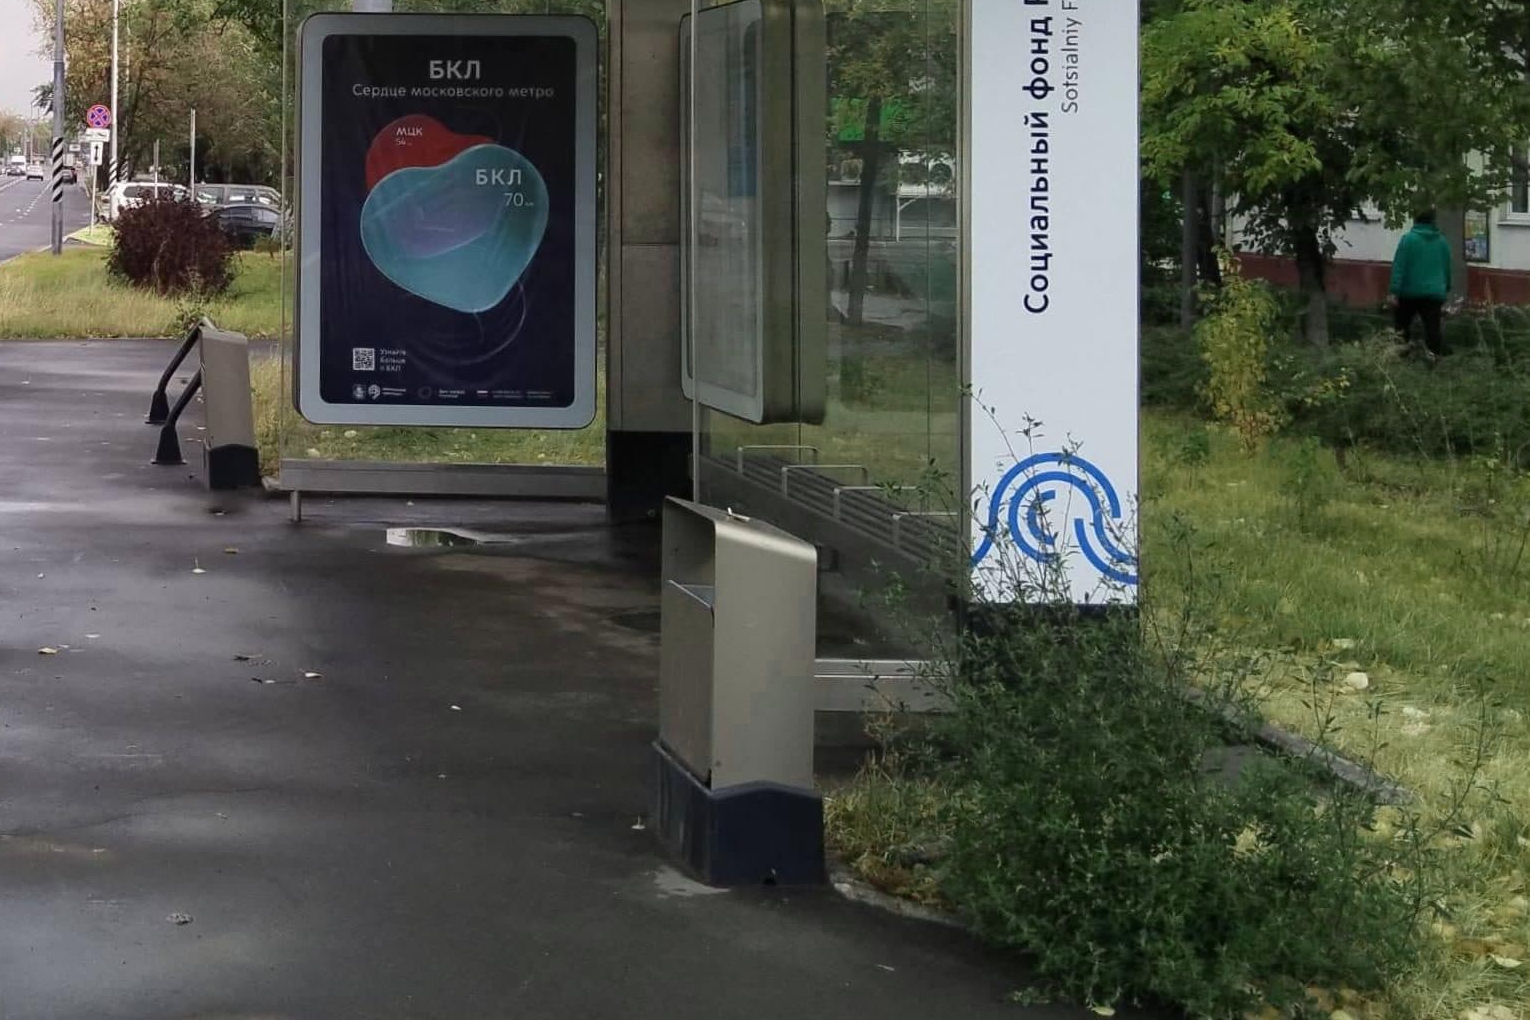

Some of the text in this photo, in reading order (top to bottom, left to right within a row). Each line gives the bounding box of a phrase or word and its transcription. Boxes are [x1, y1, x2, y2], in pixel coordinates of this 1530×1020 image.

[1022, 16, 1055, 100] фонд
[1060, 16, 1083, 114] Sotsialniy
[428, 59, 482, 80] БКЛ
[352, 83, 555, 100] Сердце московского метро
[475, 168, 522, 186] БКЛ
[504, 192, 525, 207] 70
[1023, 111, 1054, 314] Социальный
